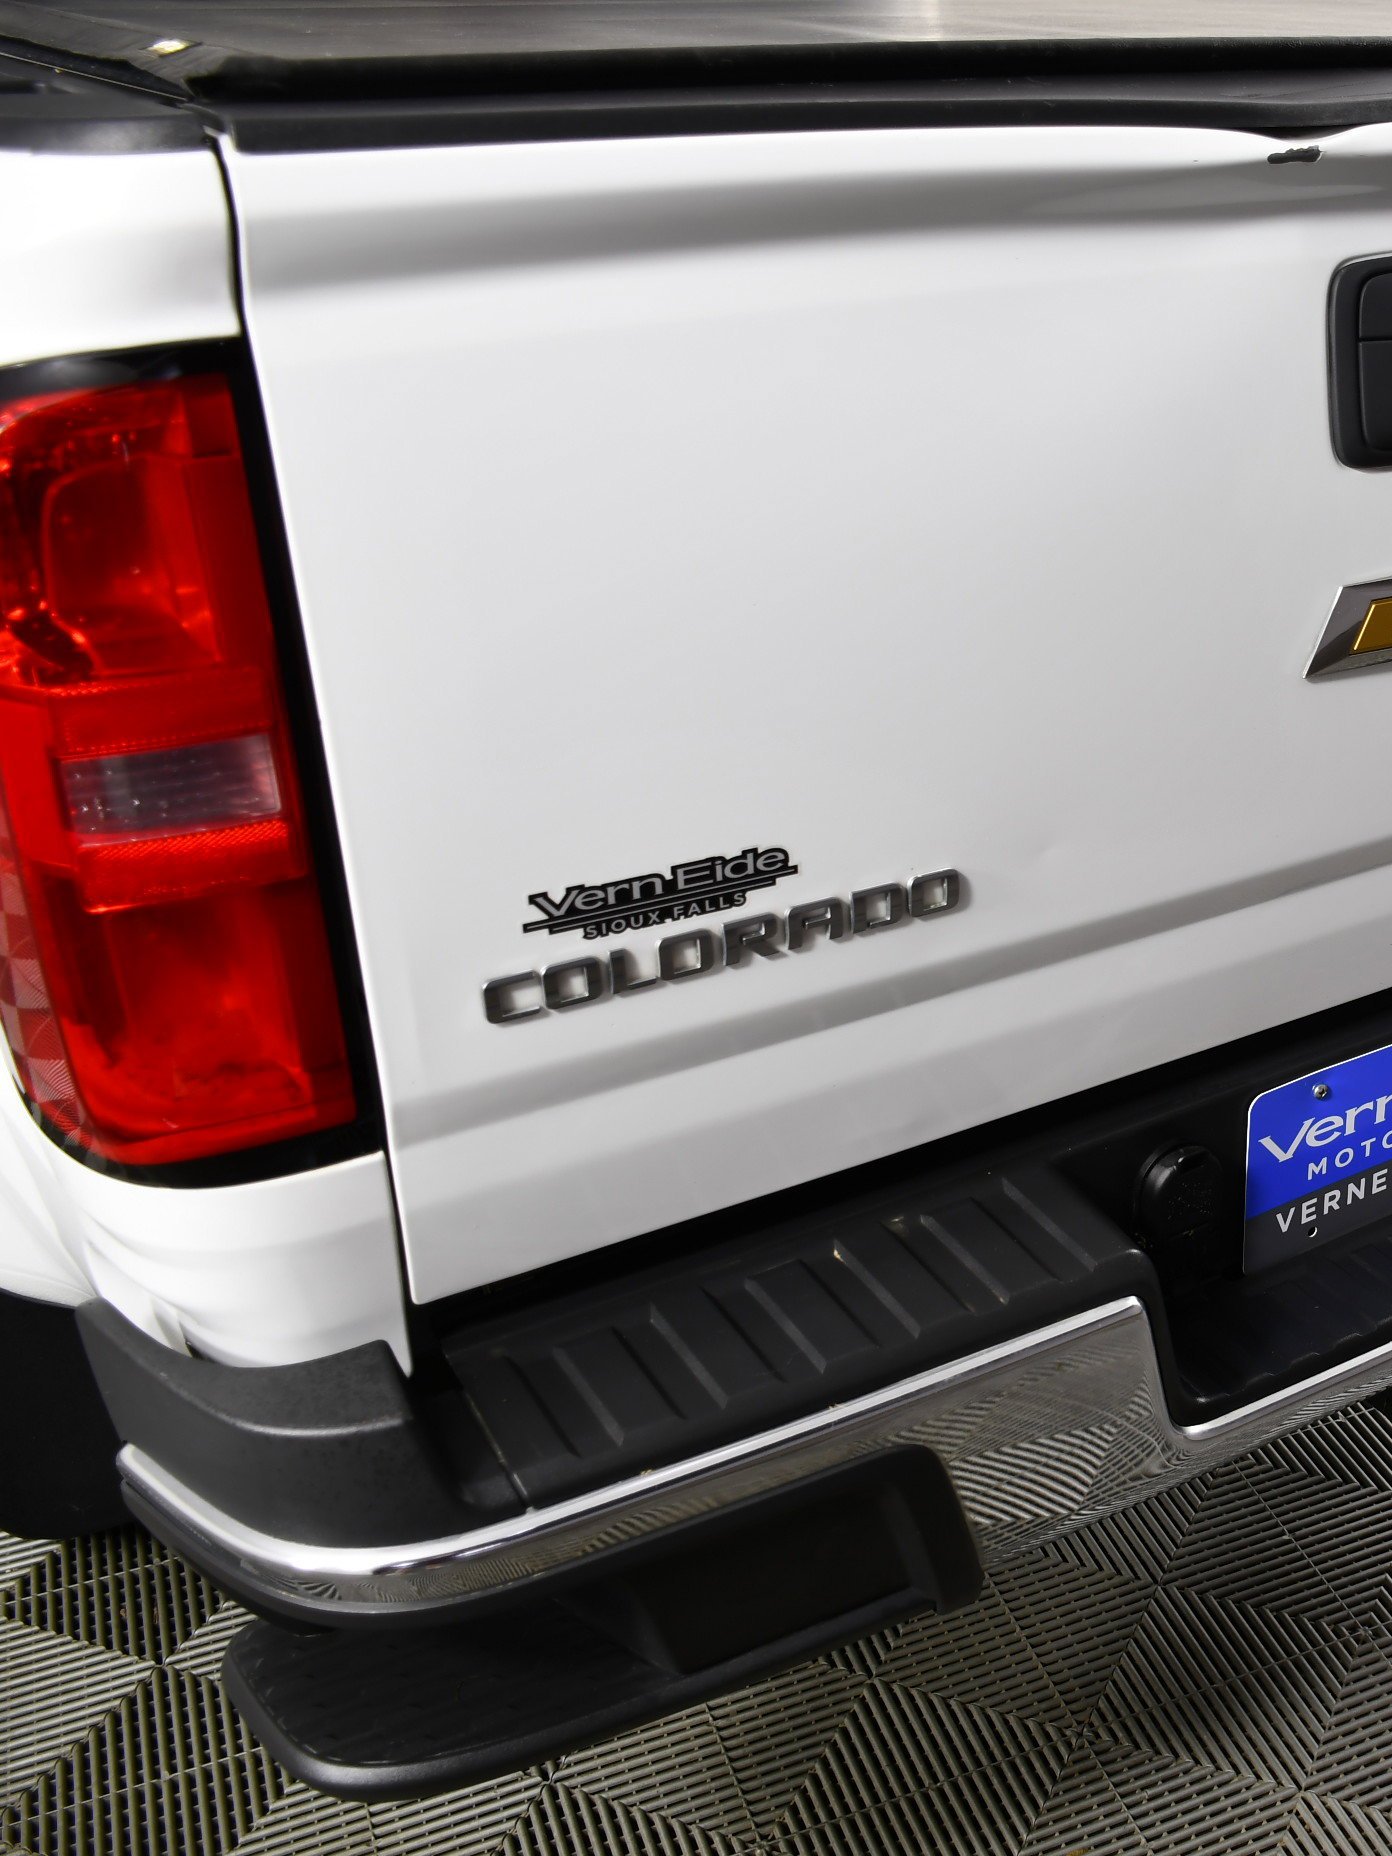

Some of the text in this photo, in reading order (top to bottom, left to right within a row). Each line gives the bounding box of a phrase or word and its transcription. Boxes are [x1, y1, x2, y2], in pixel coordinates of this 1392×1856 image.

[530, 848, 787, 918] Vern Eide
[586, 892, 746, 938] SIOUX FALLS
[483, 868, 964, 1024] COLORADO
